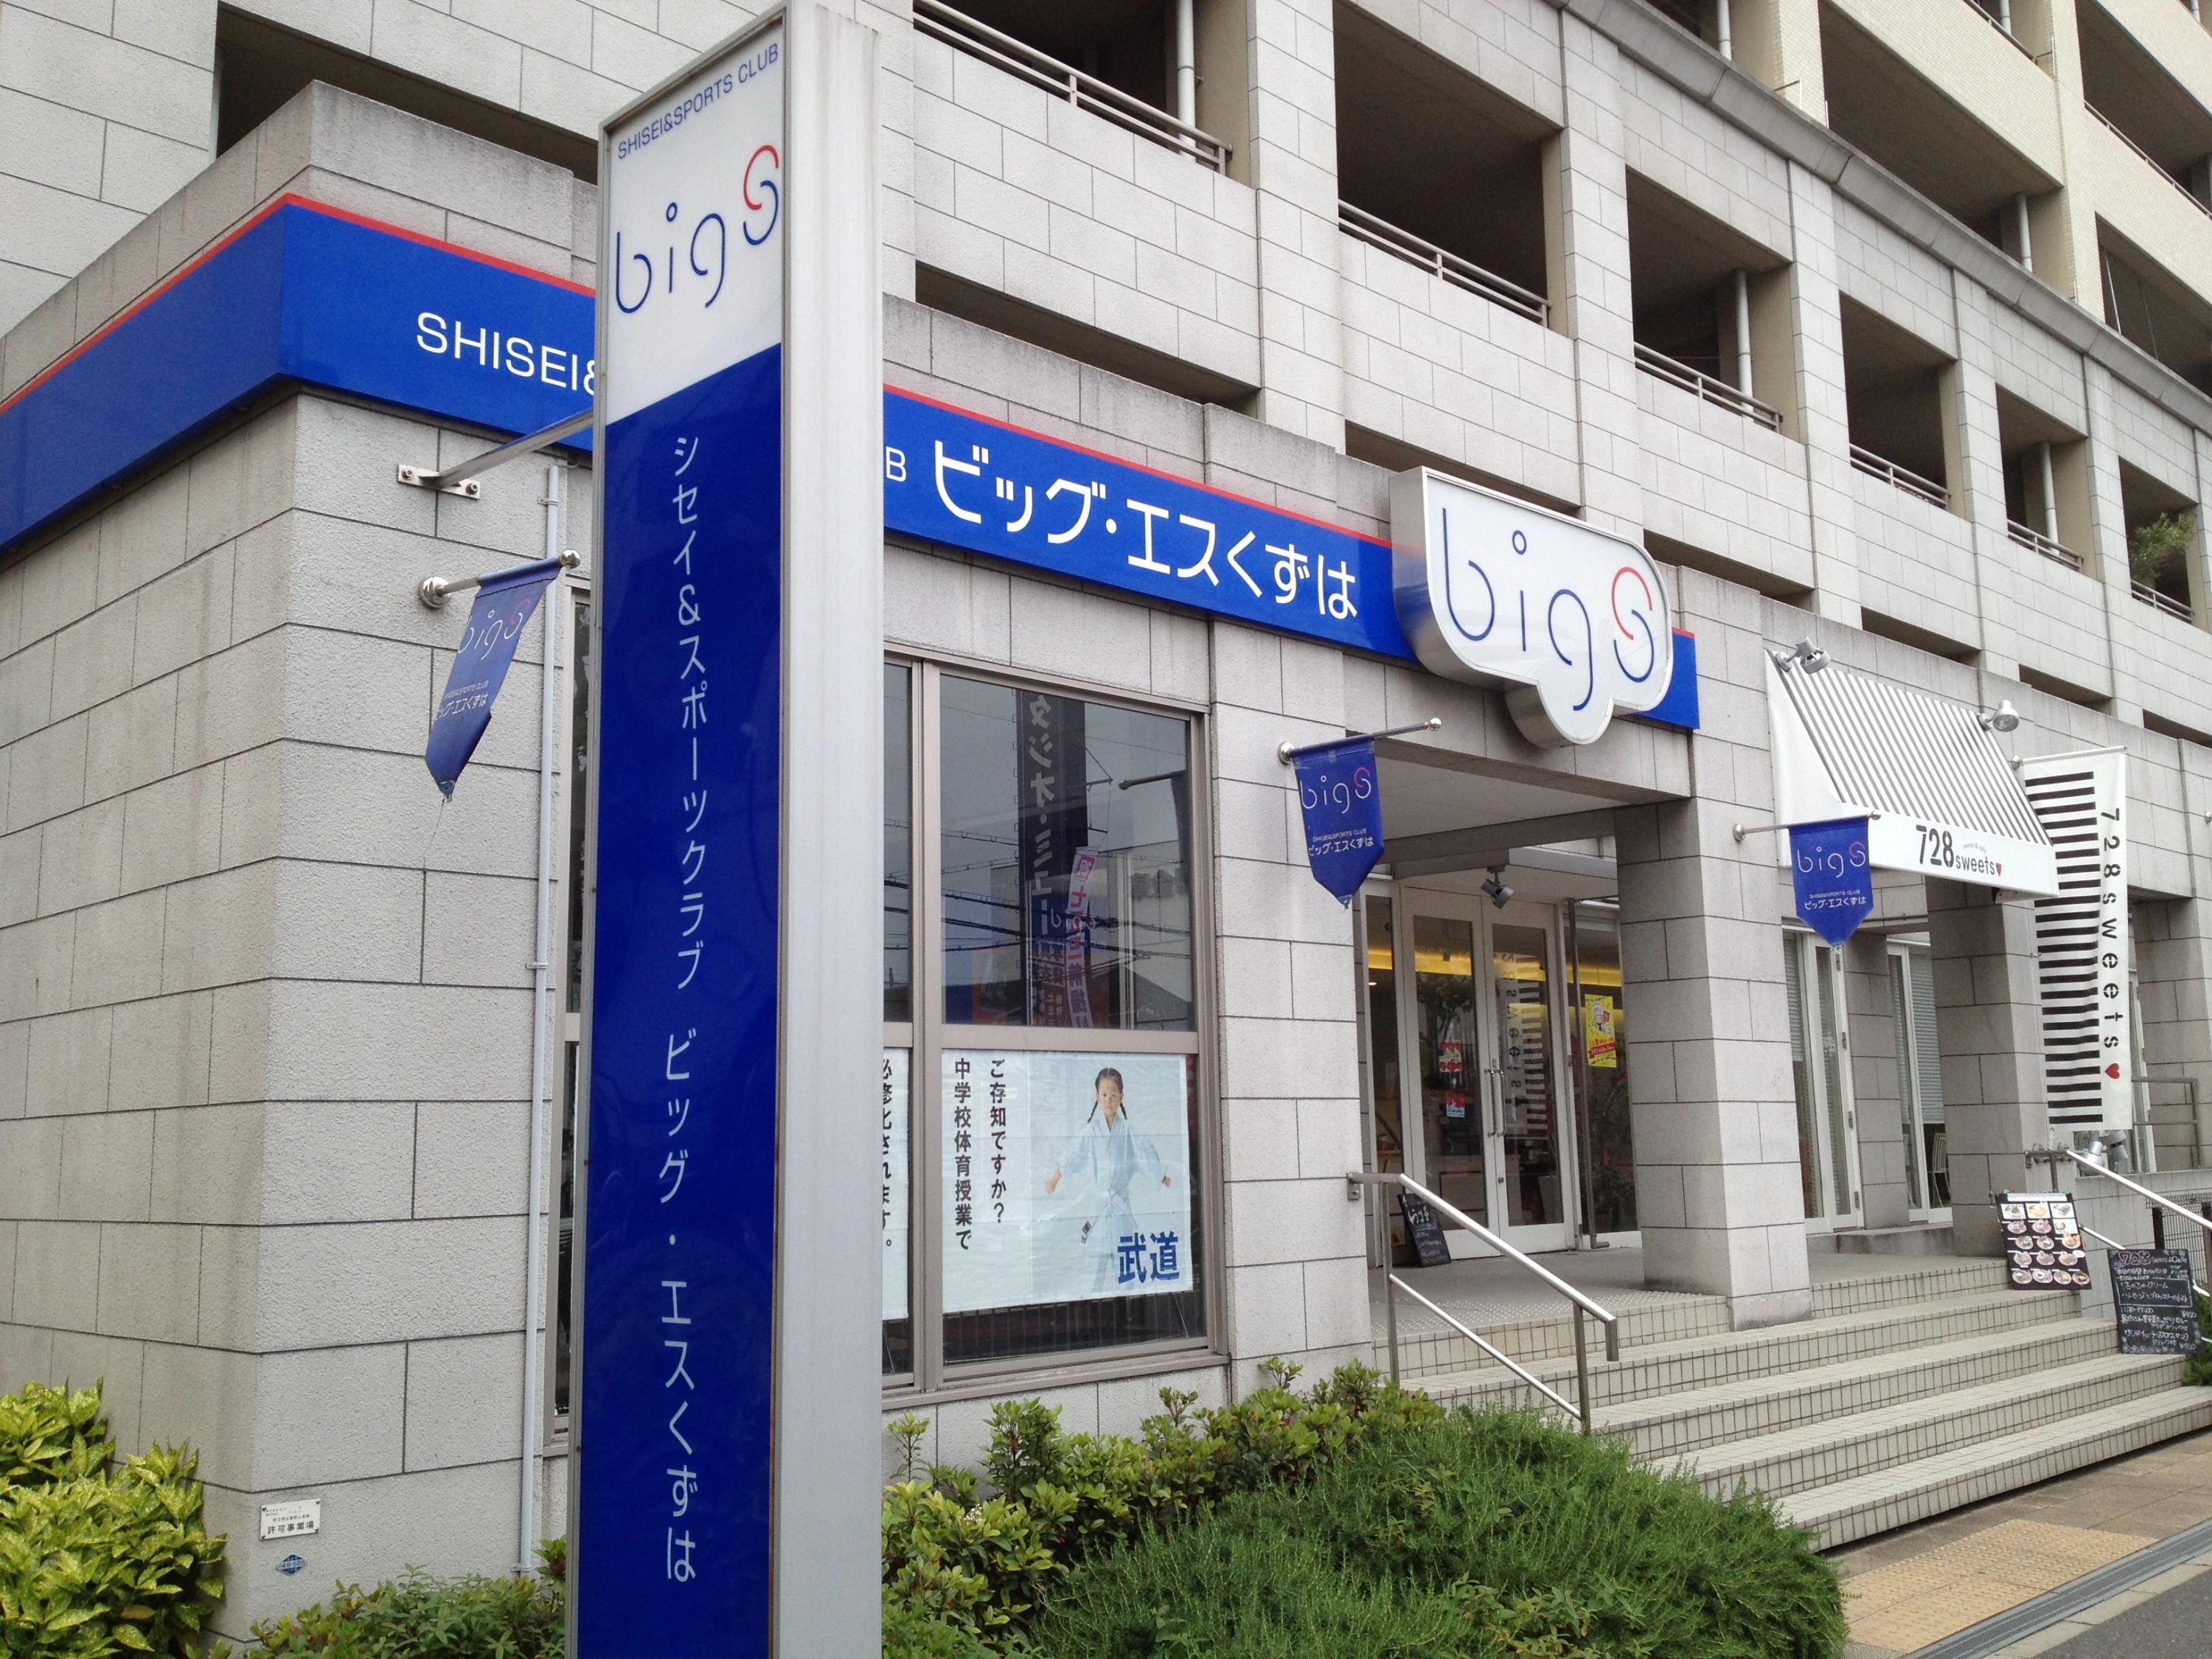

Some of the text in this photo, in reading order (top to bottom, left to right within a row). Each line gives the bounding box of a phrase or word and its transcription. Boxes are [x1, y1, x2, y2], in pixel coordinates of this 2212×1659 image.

[618, 43, 779, 160] SHISEI&SPORTS CLUB
[934, 440, 1358, 620] ビッグ・エスくずは
[953, 1057, 973, 1251] 中学校体育授業で
[658, 1026, 698, 1583] ビッグ・エスくずは
[1117, 1231, 1180, 1284] 武道
